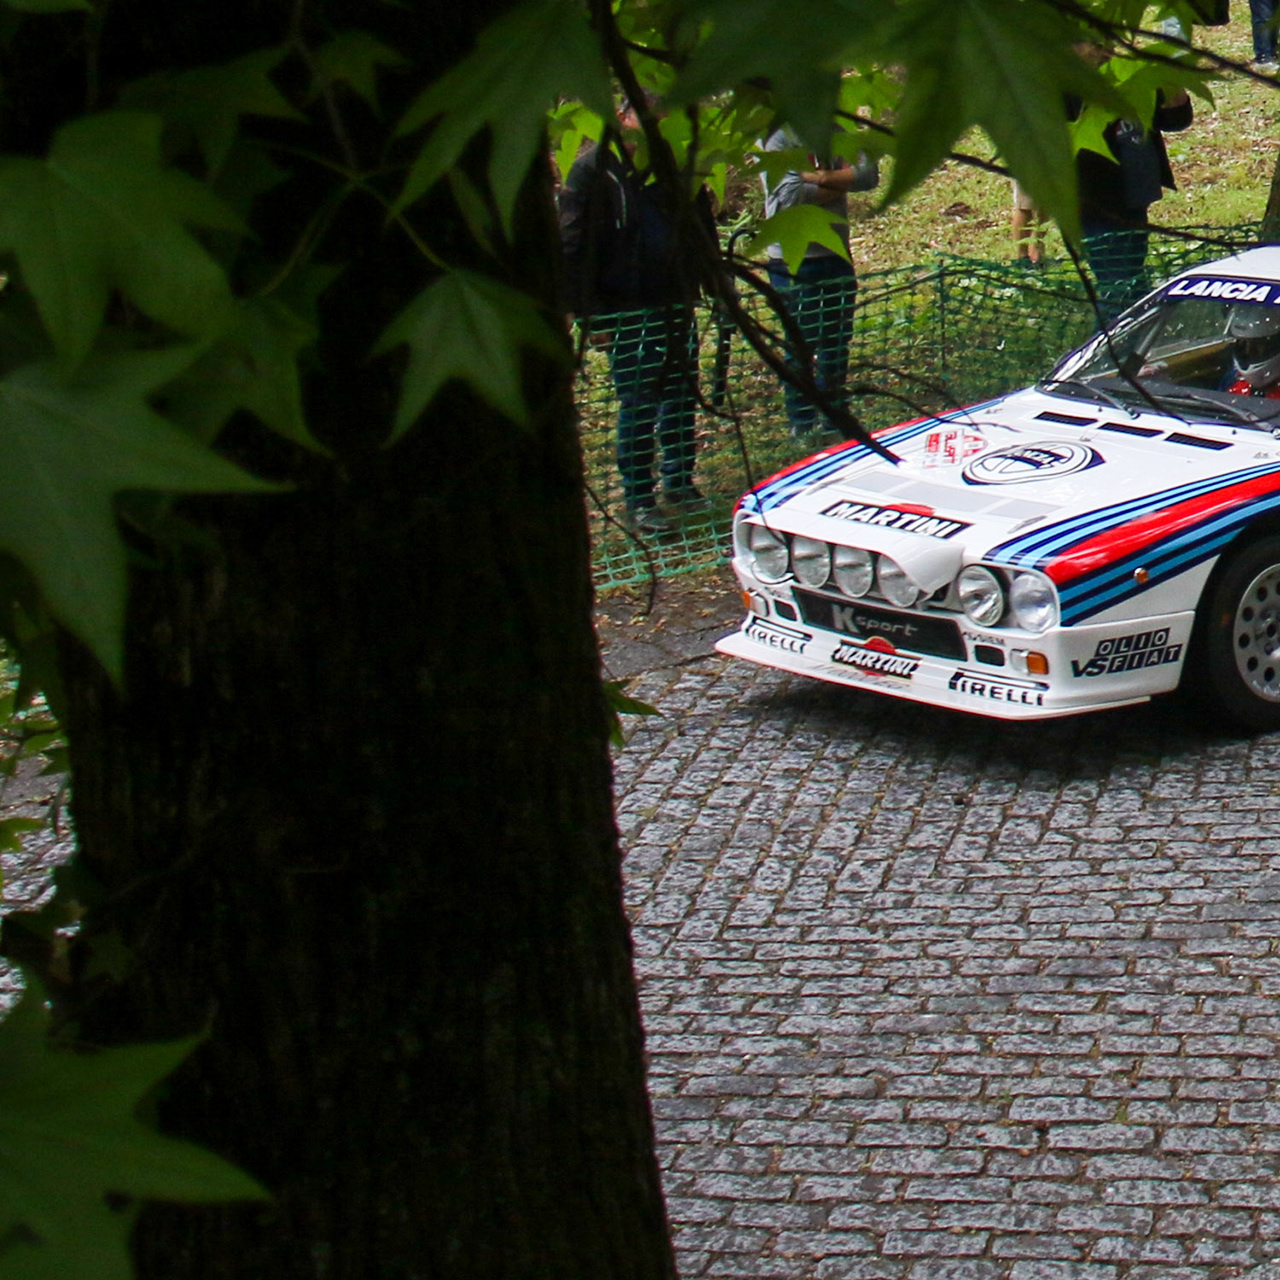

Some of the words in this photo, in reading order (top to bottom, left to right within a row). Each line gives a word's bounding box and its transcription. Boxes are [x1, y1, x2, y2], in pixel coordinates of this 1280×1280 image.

[1167, 279, 1272, 303] LANCIA
[825, 501, 962, 539] MARTINI
[1098, 630, 1169, 656] OLIO
[833, 644, 918, 677] MARTINI
[1070, 657, 1111, 678] VS
[1111, 645, 1183, 672] FIAT
[948, 666, 1050, 707] PIRELLI
